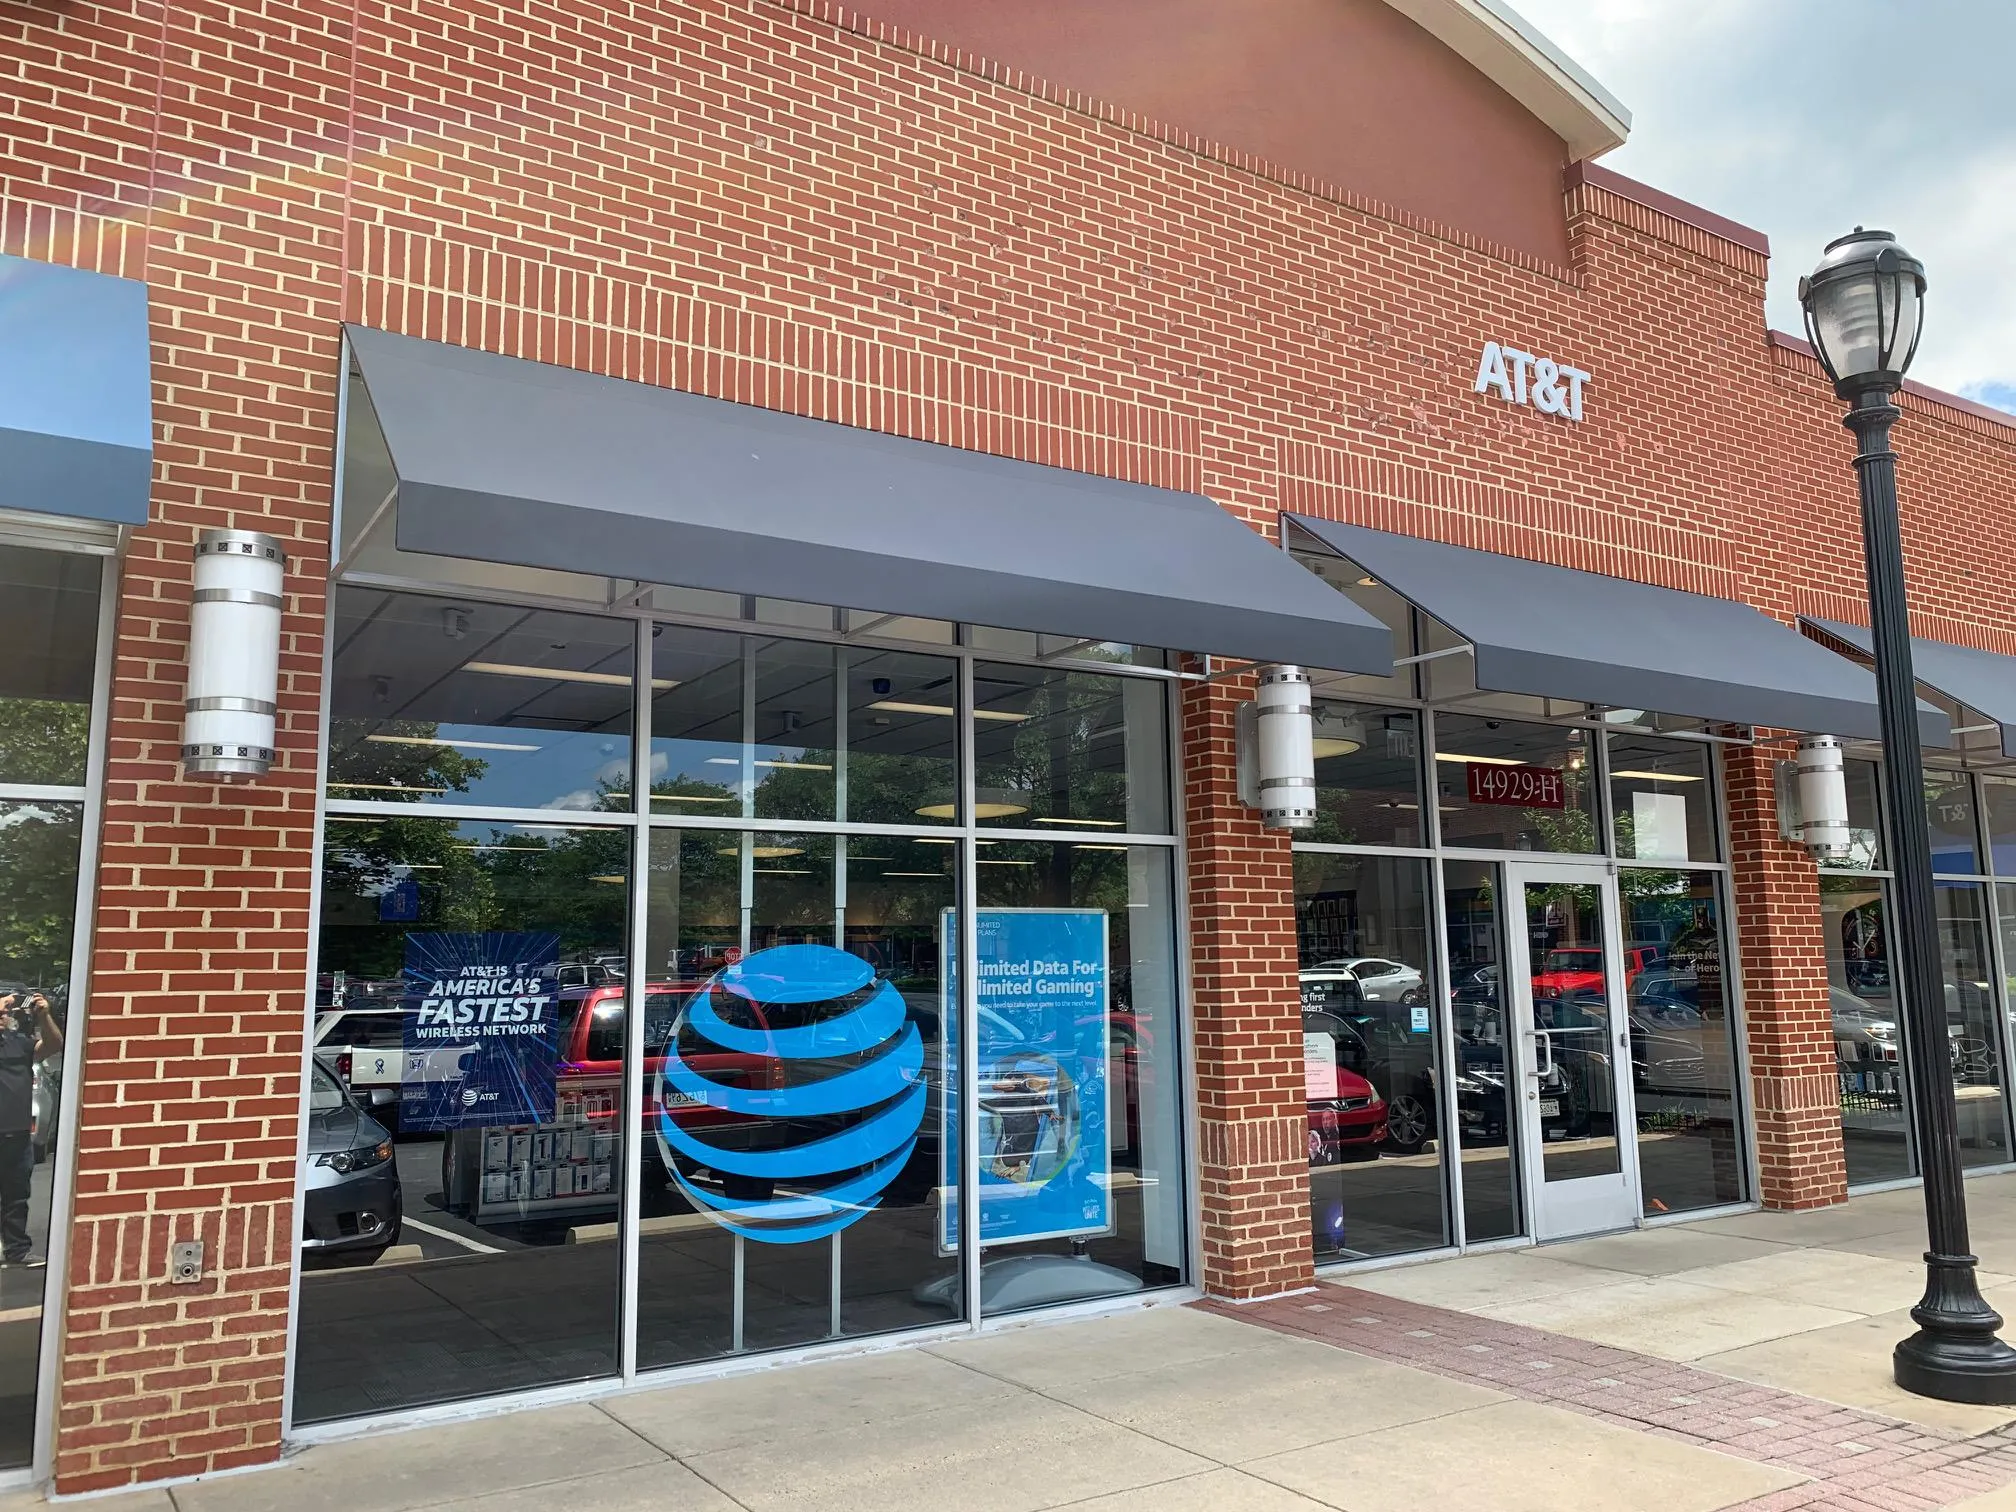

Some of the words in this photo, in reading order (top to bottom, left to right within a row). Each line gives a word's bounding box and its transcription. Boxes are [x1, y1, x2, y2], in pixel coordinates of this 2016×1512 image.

[1474, 340, 1592, 422] AT&T
[1473, 767, 1560, 803] 14929-H
[1687, 950, 1703, 960] the
[1704, 950, 1720, 960] Ne
[460, 965, 495, 977] AT&T
[496, 965, 508, 977] IS
[1033, 960, 1069, 976] Data
[1072, 960, 1098, 975] For
[1684, 963, 1695, 972] of
[428, 977, 542, 997] AMERICA'S
[976, 978, 1033, 996] limited
[1035, 978, 1095, 998] Gaming
[1309, 992, 1326, 1001] first
[416, 996, 551, 1025] FASTEST
[416, 1025, 480, 1039] WIRELESS
[482, 1023, 547, 1036] NETWORK
[479, 1092, 500, 1101] AT&T
